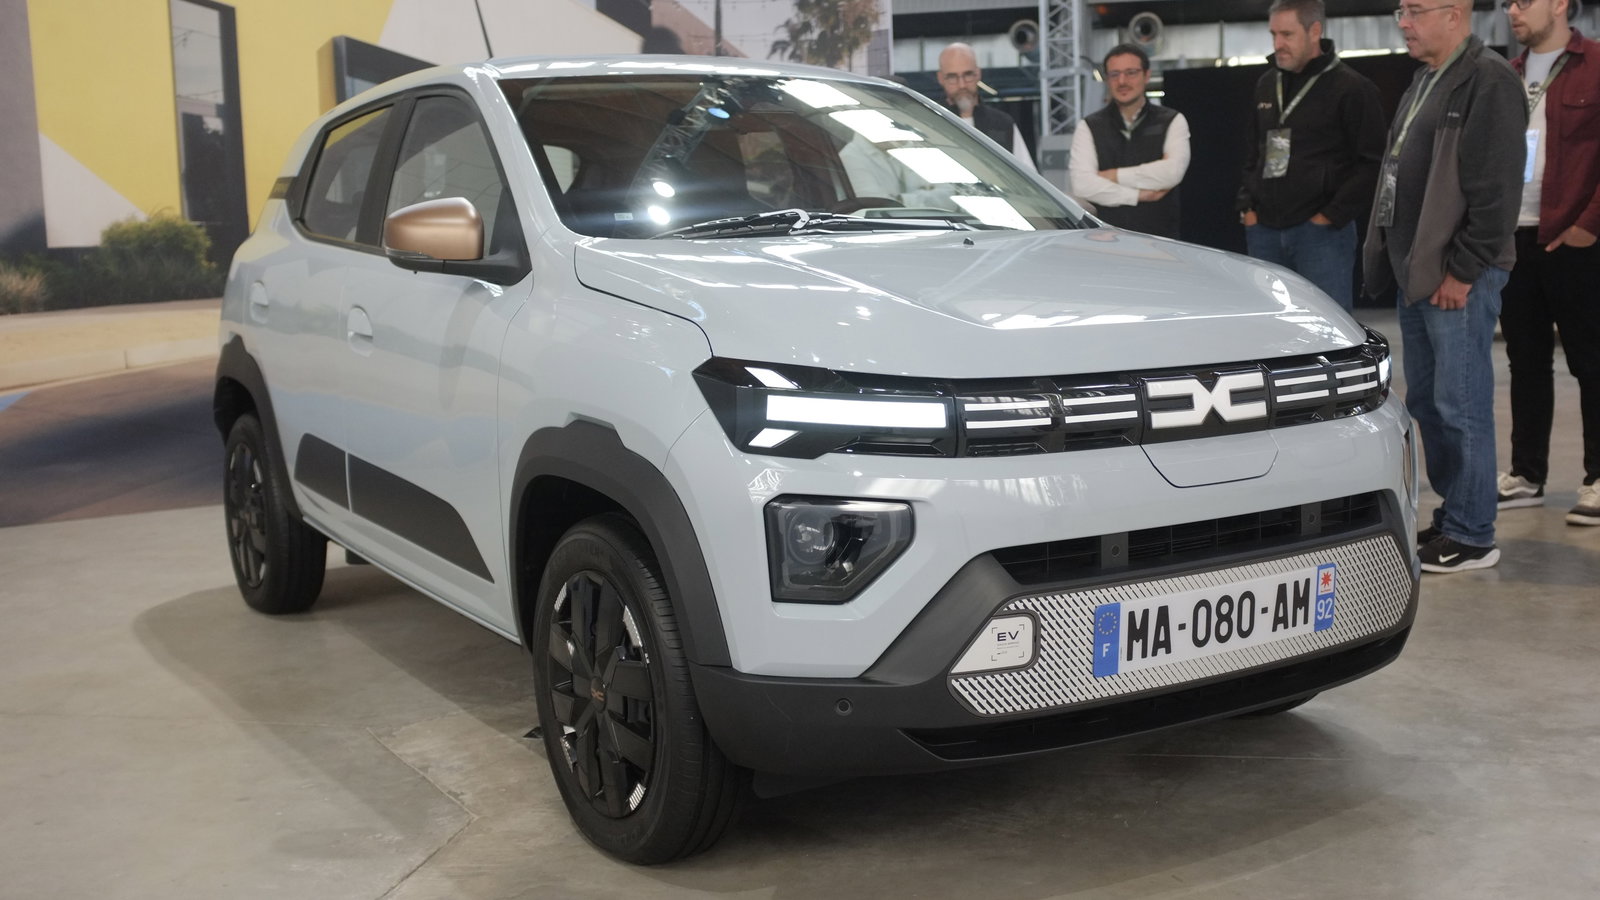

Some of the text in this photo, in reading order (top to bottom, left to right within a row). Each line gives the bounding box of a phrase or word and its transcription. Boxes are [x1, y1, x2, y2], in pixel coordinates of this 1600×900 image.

[997, 630, 1019, 642] EV
[1102, 642, 1111, 658] F
[1126, 577, 1311, 662] MA-080-AM
[1317, 597, 1333, 621] 92
